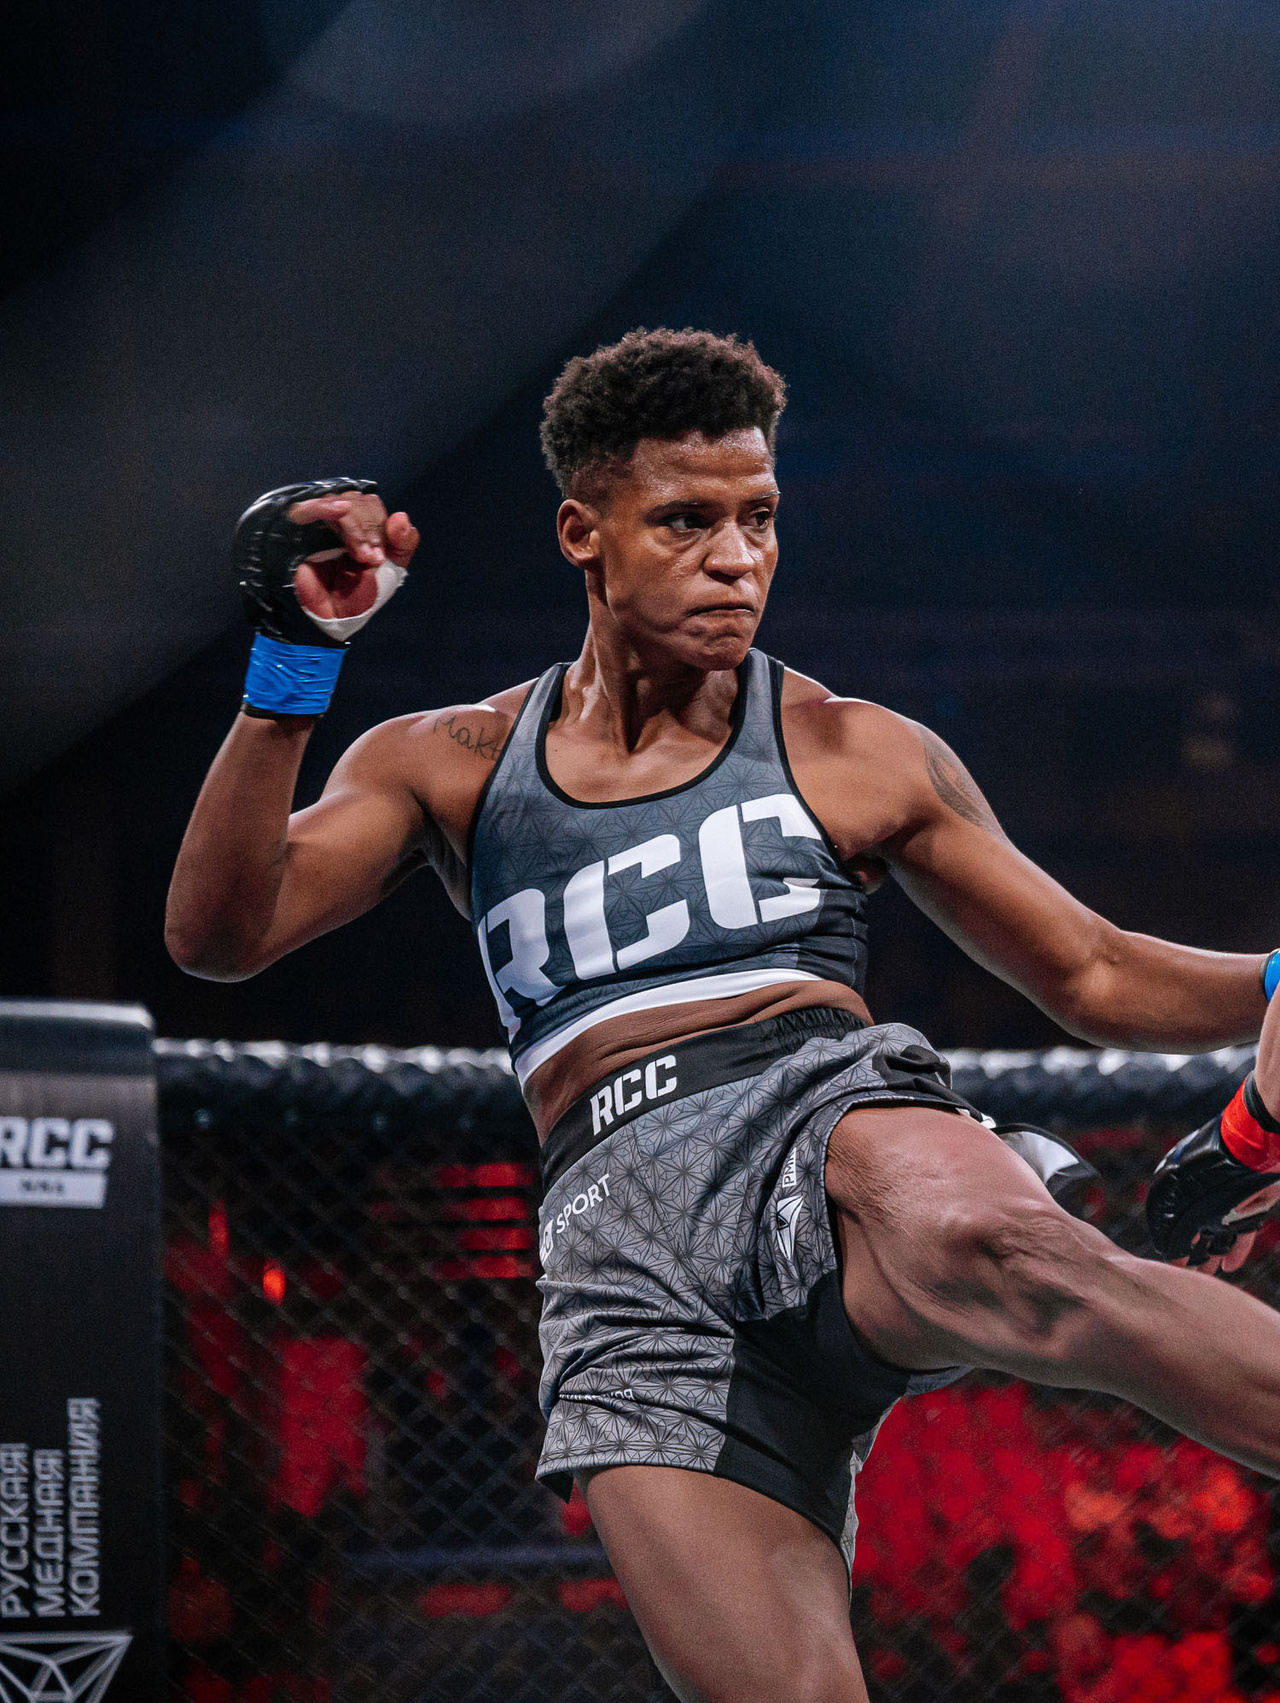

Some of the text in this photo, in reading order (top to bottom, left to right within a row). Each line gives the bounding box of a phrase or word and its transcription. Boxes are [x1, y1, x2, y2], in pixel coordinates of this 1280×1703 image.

[477, 793, 822, 1045] RCC
[0, 1116, 114, 1169] RCC
[589, 1054, 678, 1137] RCC
[556, 1173, 610, 1234] SPORT
[0, 1442, 30, 1618] РУССКАЯ
[34, 1449, 66, 1618] МЕДНАЯ
[68, 1397, 101, 1617] КОМПАНИЯ
